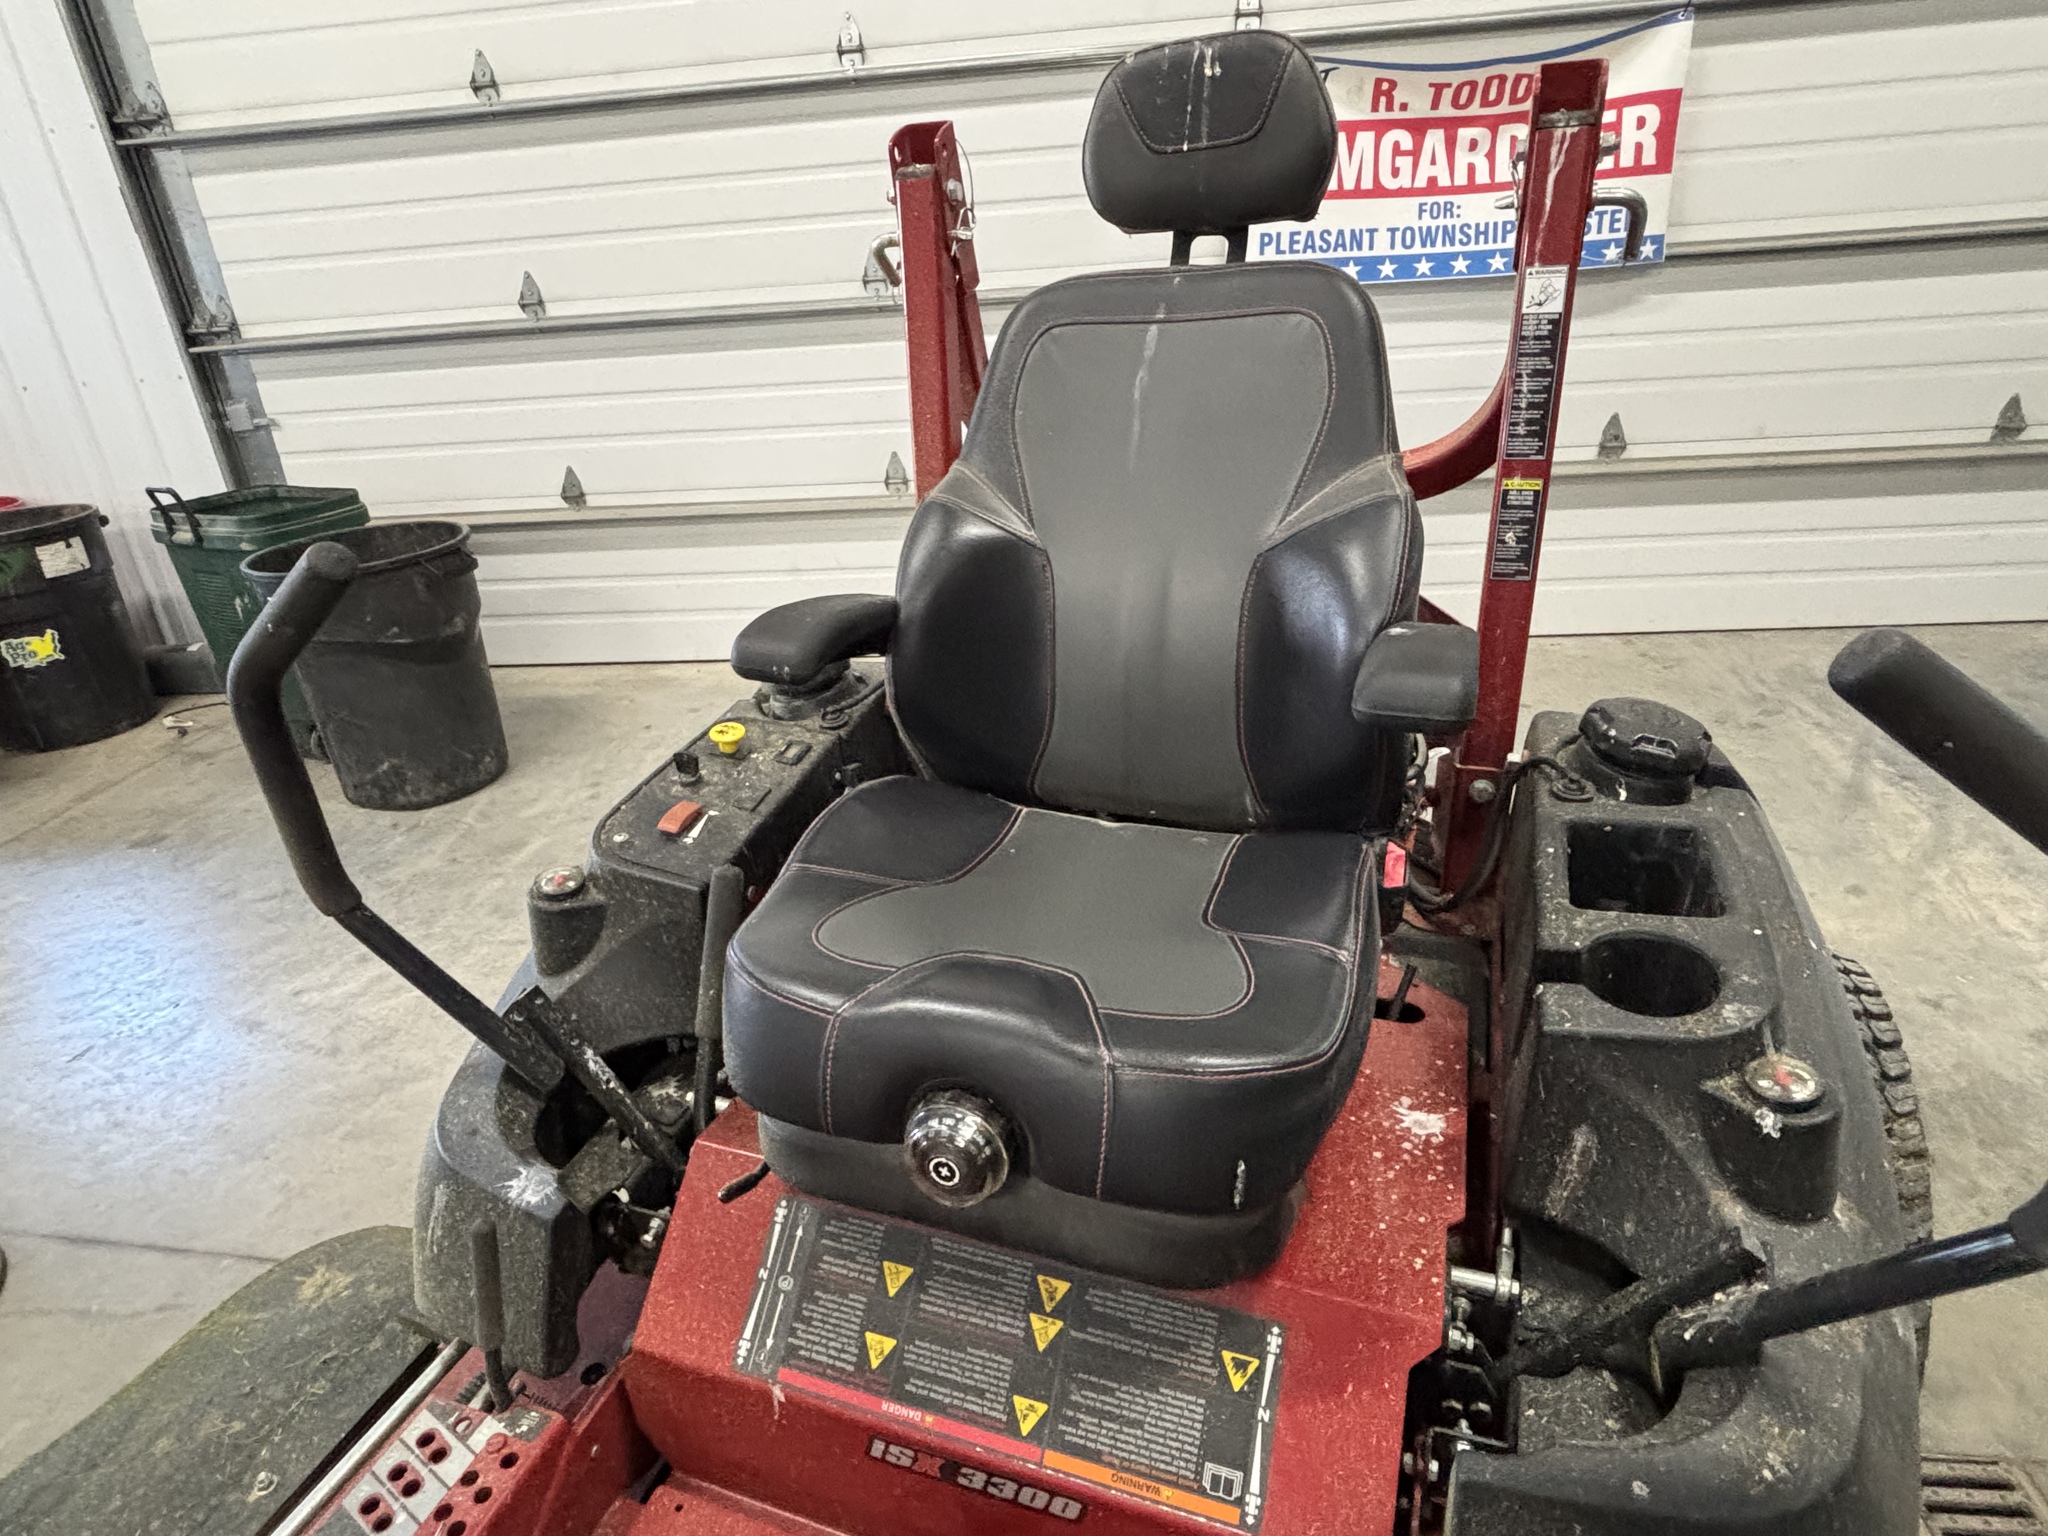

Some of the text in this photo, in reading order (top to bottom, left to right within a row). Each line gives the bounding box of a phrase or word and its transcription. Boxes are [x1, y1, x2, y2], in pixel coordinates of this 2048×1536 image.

[1371, 73, 1535, 113] R. TODD
[1418, 201, 1462, 221] FOR:
[1259, 220, 1516, 256] PLEASANT TOWNSHIP
[1534, 268, 1567, 276] WARNING
[10, 651, 38, 664] Pro
[881, 1400, 923, 1422] DANGER
[869, 1438, 1084, 1521] ISX 3300
[1110, 1472, 1162, 1496] WARNING
